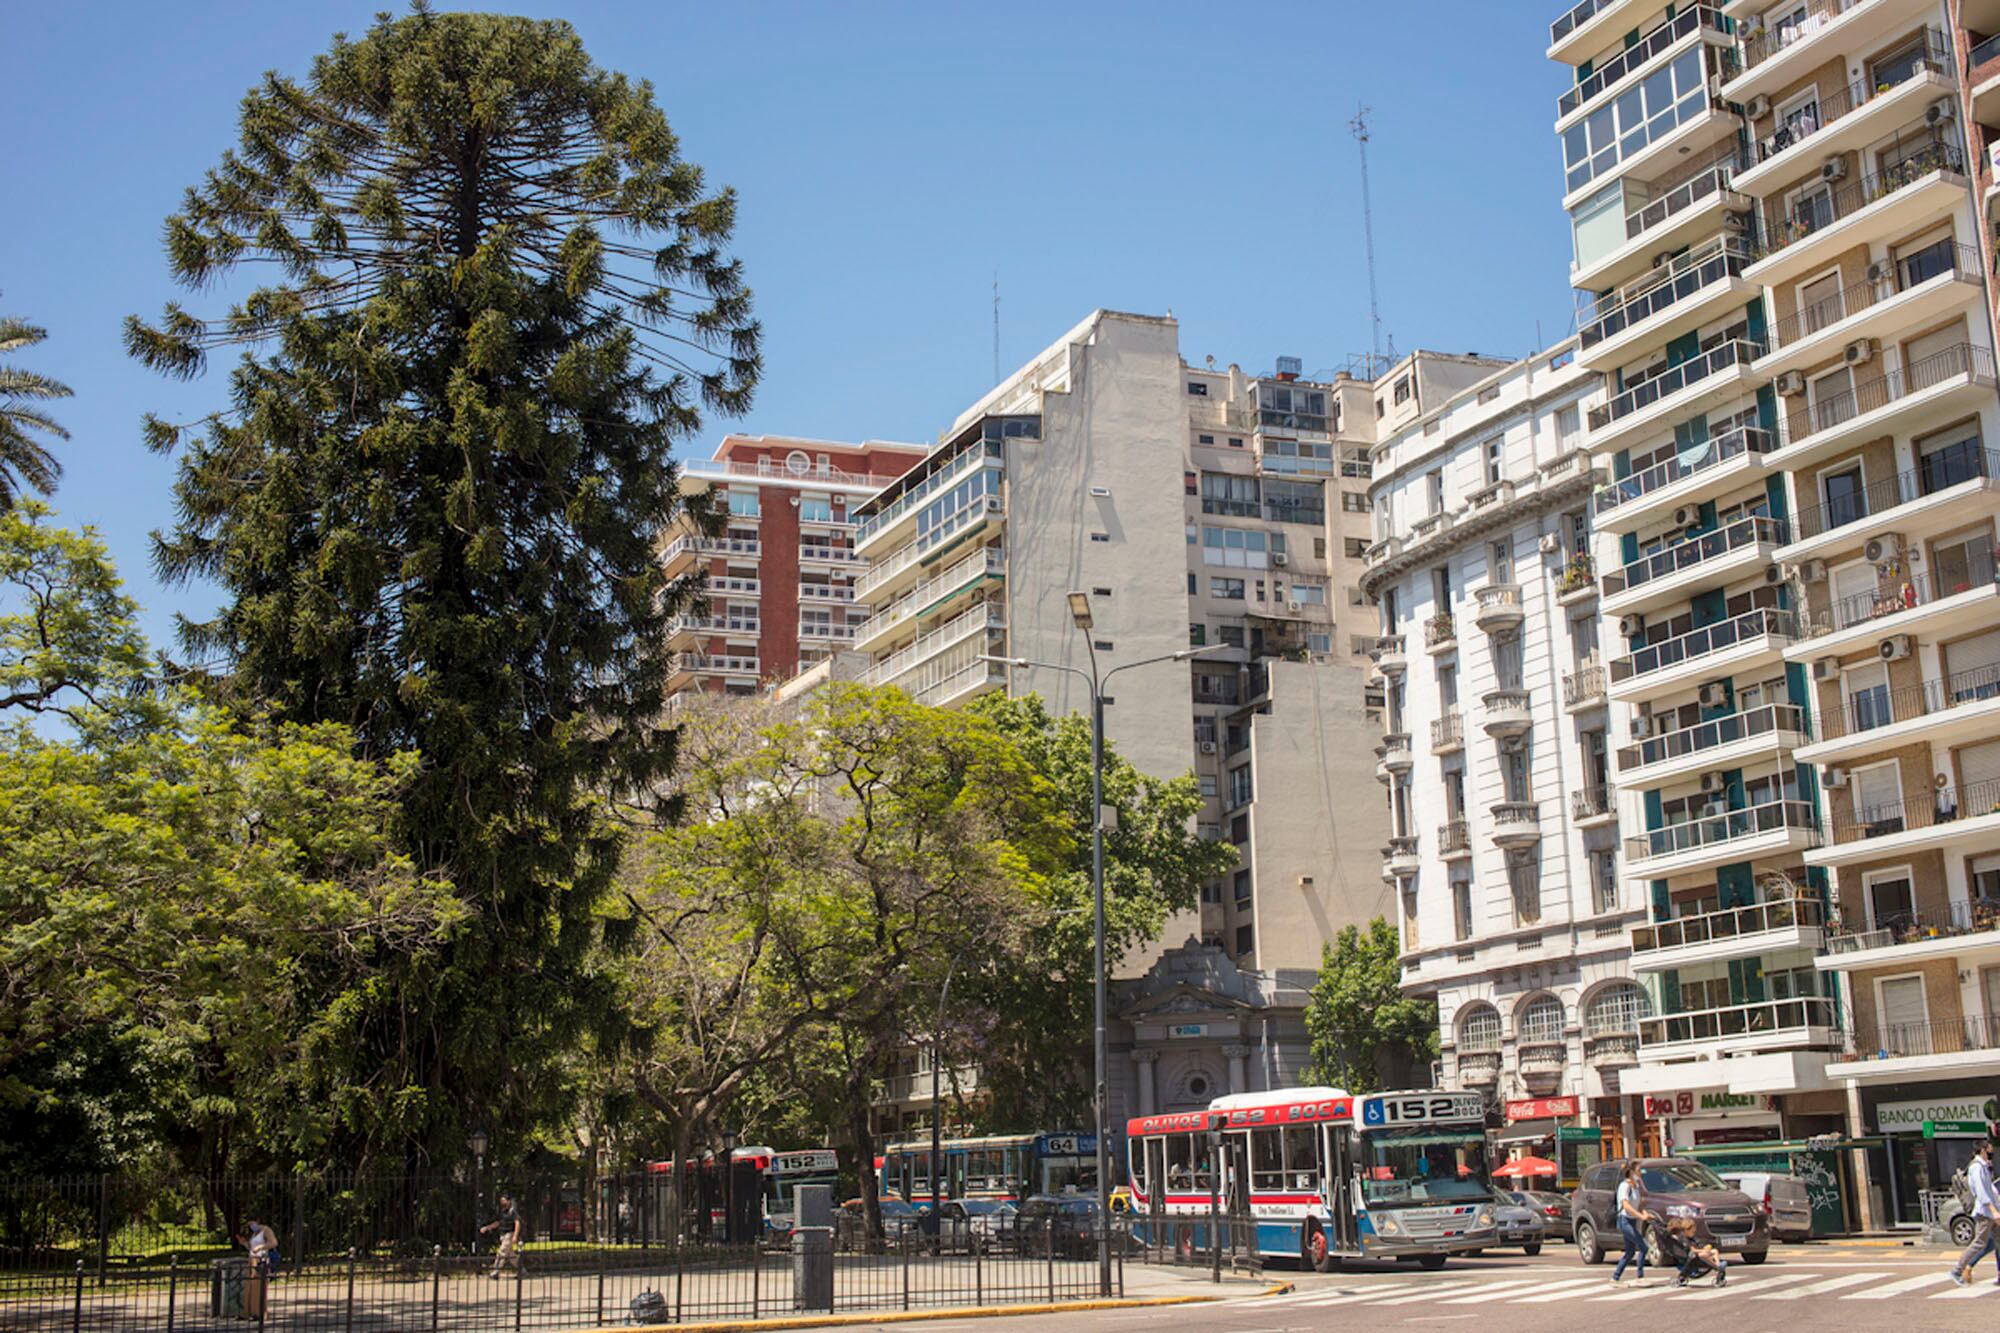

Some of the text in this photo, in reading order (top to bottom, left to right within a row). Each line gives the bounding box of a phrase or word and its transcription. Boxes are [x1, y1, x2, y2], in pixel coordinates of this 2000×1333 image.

[1454, 1097, 1481, 1106] OLIVOS
[1143, 1115, 1201, 1131] OLIVOS
[1288, 1100, 1347, 1121] BOCA
[1385, 1099, 1454, 1120] 152
[1454, 1107, 1481, 1117] BOCA
[1880, 1104, 1980, 1125] BANCO COMAFI
[1050, 1139, 1073, 1151] 64
[780, 1156, 815, 1168] 152
